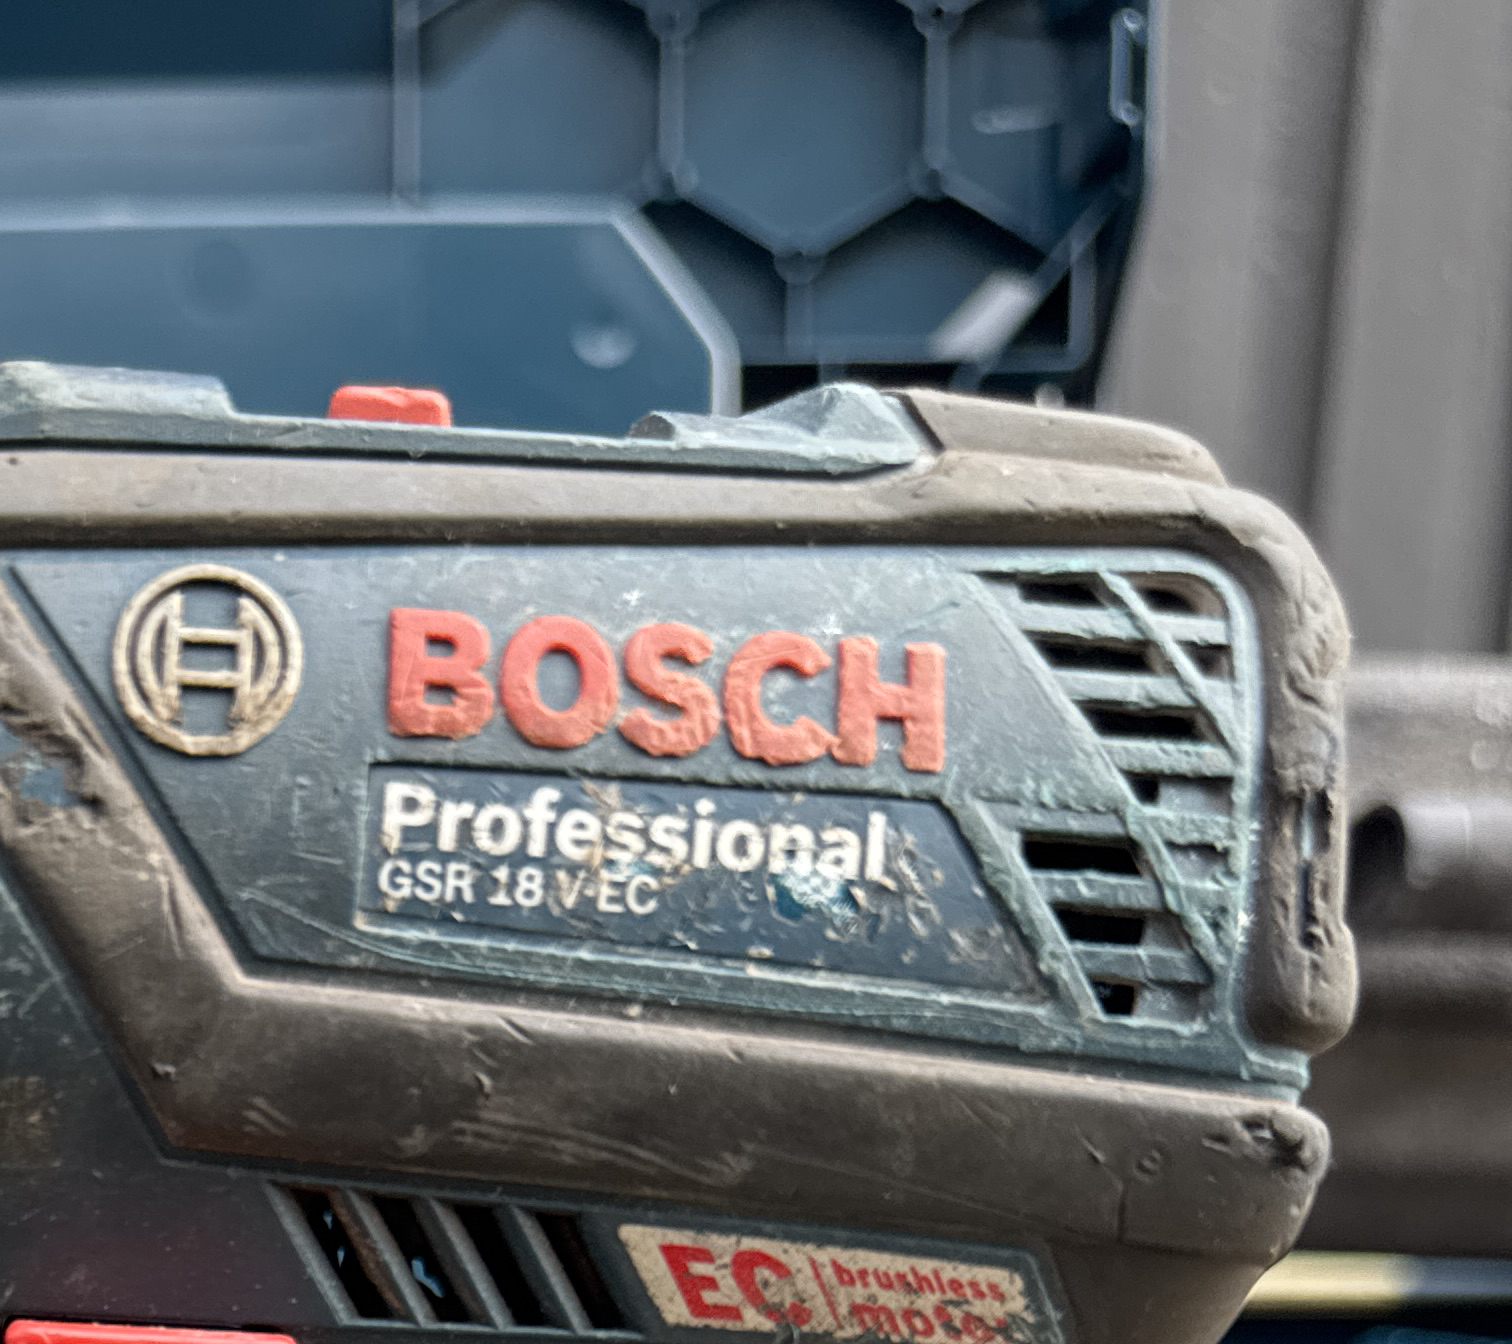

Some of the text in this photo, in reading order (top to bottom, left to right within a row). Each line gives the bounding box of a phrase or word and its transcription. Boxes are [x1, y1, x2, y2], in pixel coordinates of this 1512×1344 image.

[387, 607, 947, 773] BOSCH
[381, 780, 889, 882] Professional
[377, 859, 475, 904] GSR
[489, 866, 544, 907] 18
[658, 1243, 1006, 1327] EC brushless
